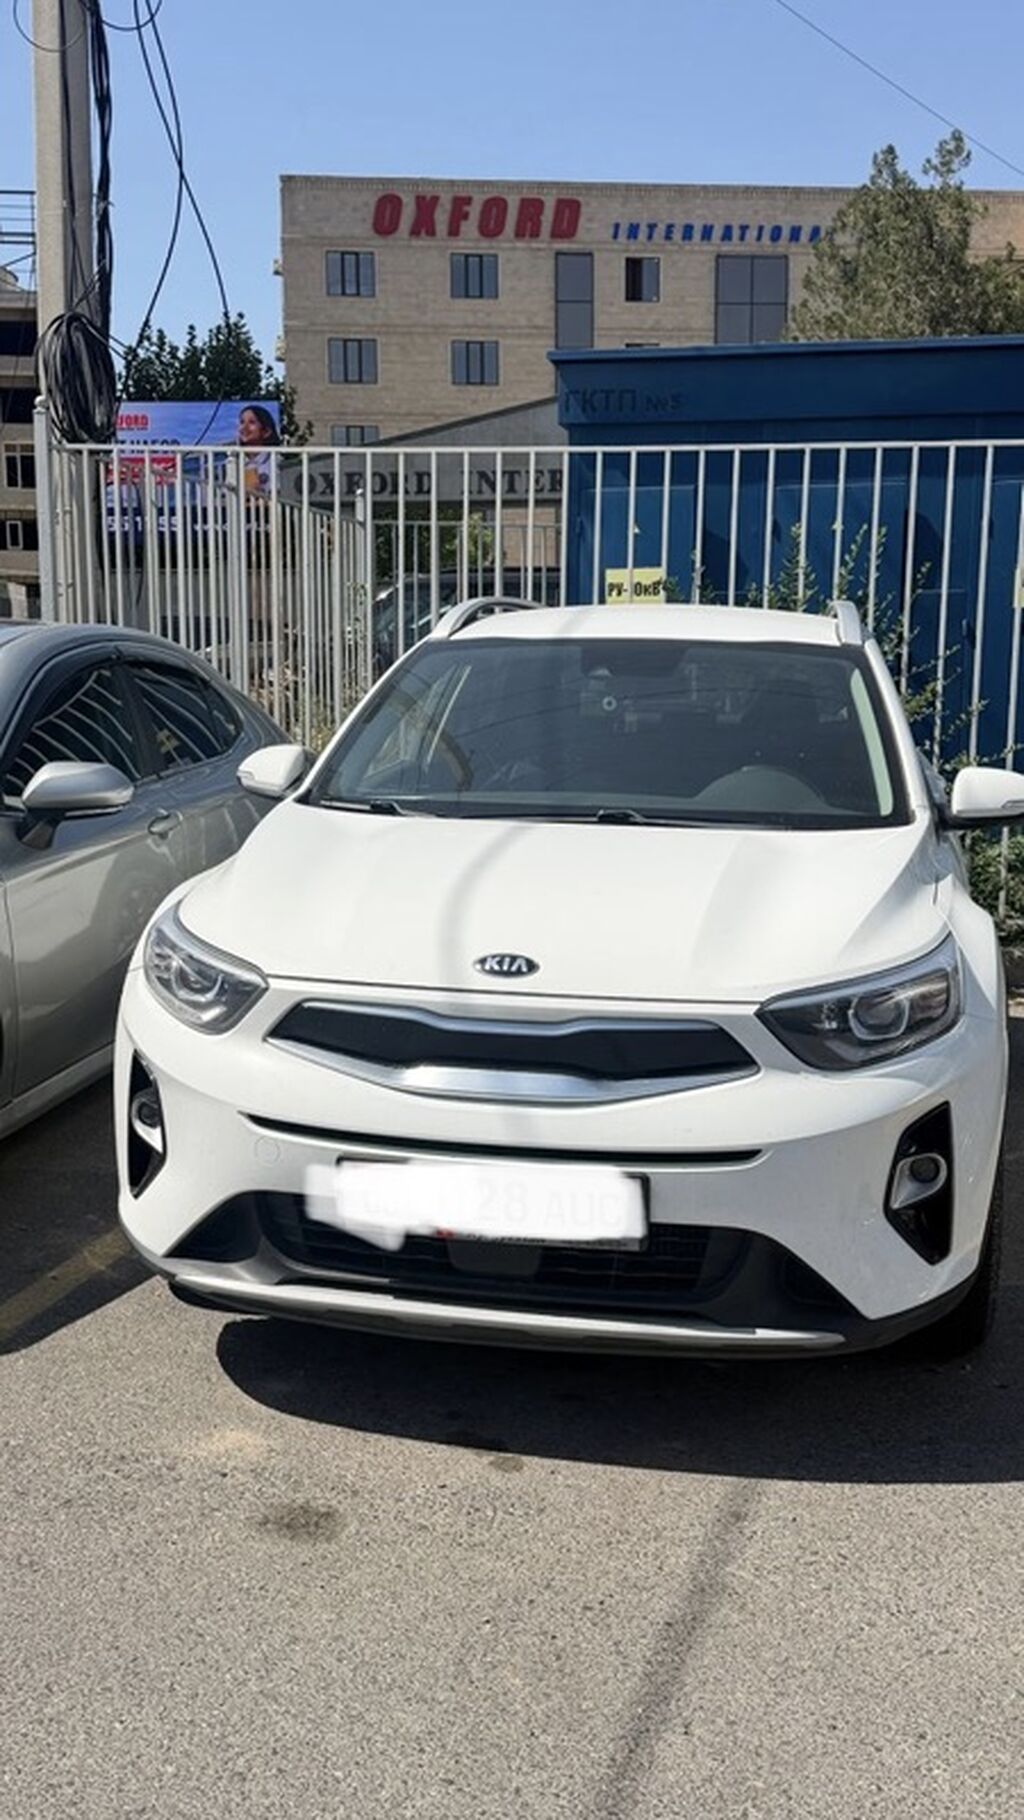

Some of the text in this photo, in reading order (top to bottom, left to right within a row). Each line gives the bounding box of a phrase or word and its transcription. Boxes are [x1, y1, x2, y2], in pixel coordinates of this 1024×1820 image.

[371, 193, 583, 239] OXFORD
[612, 222, 828, 245] INTERNATIONA
[564, 388, 637, 413] ГКТП
[292, 470, 432, 496] OXFORD
[607, 581, 661, 597] РУ-0кВ
[483, 956, 529, 973] KIA
